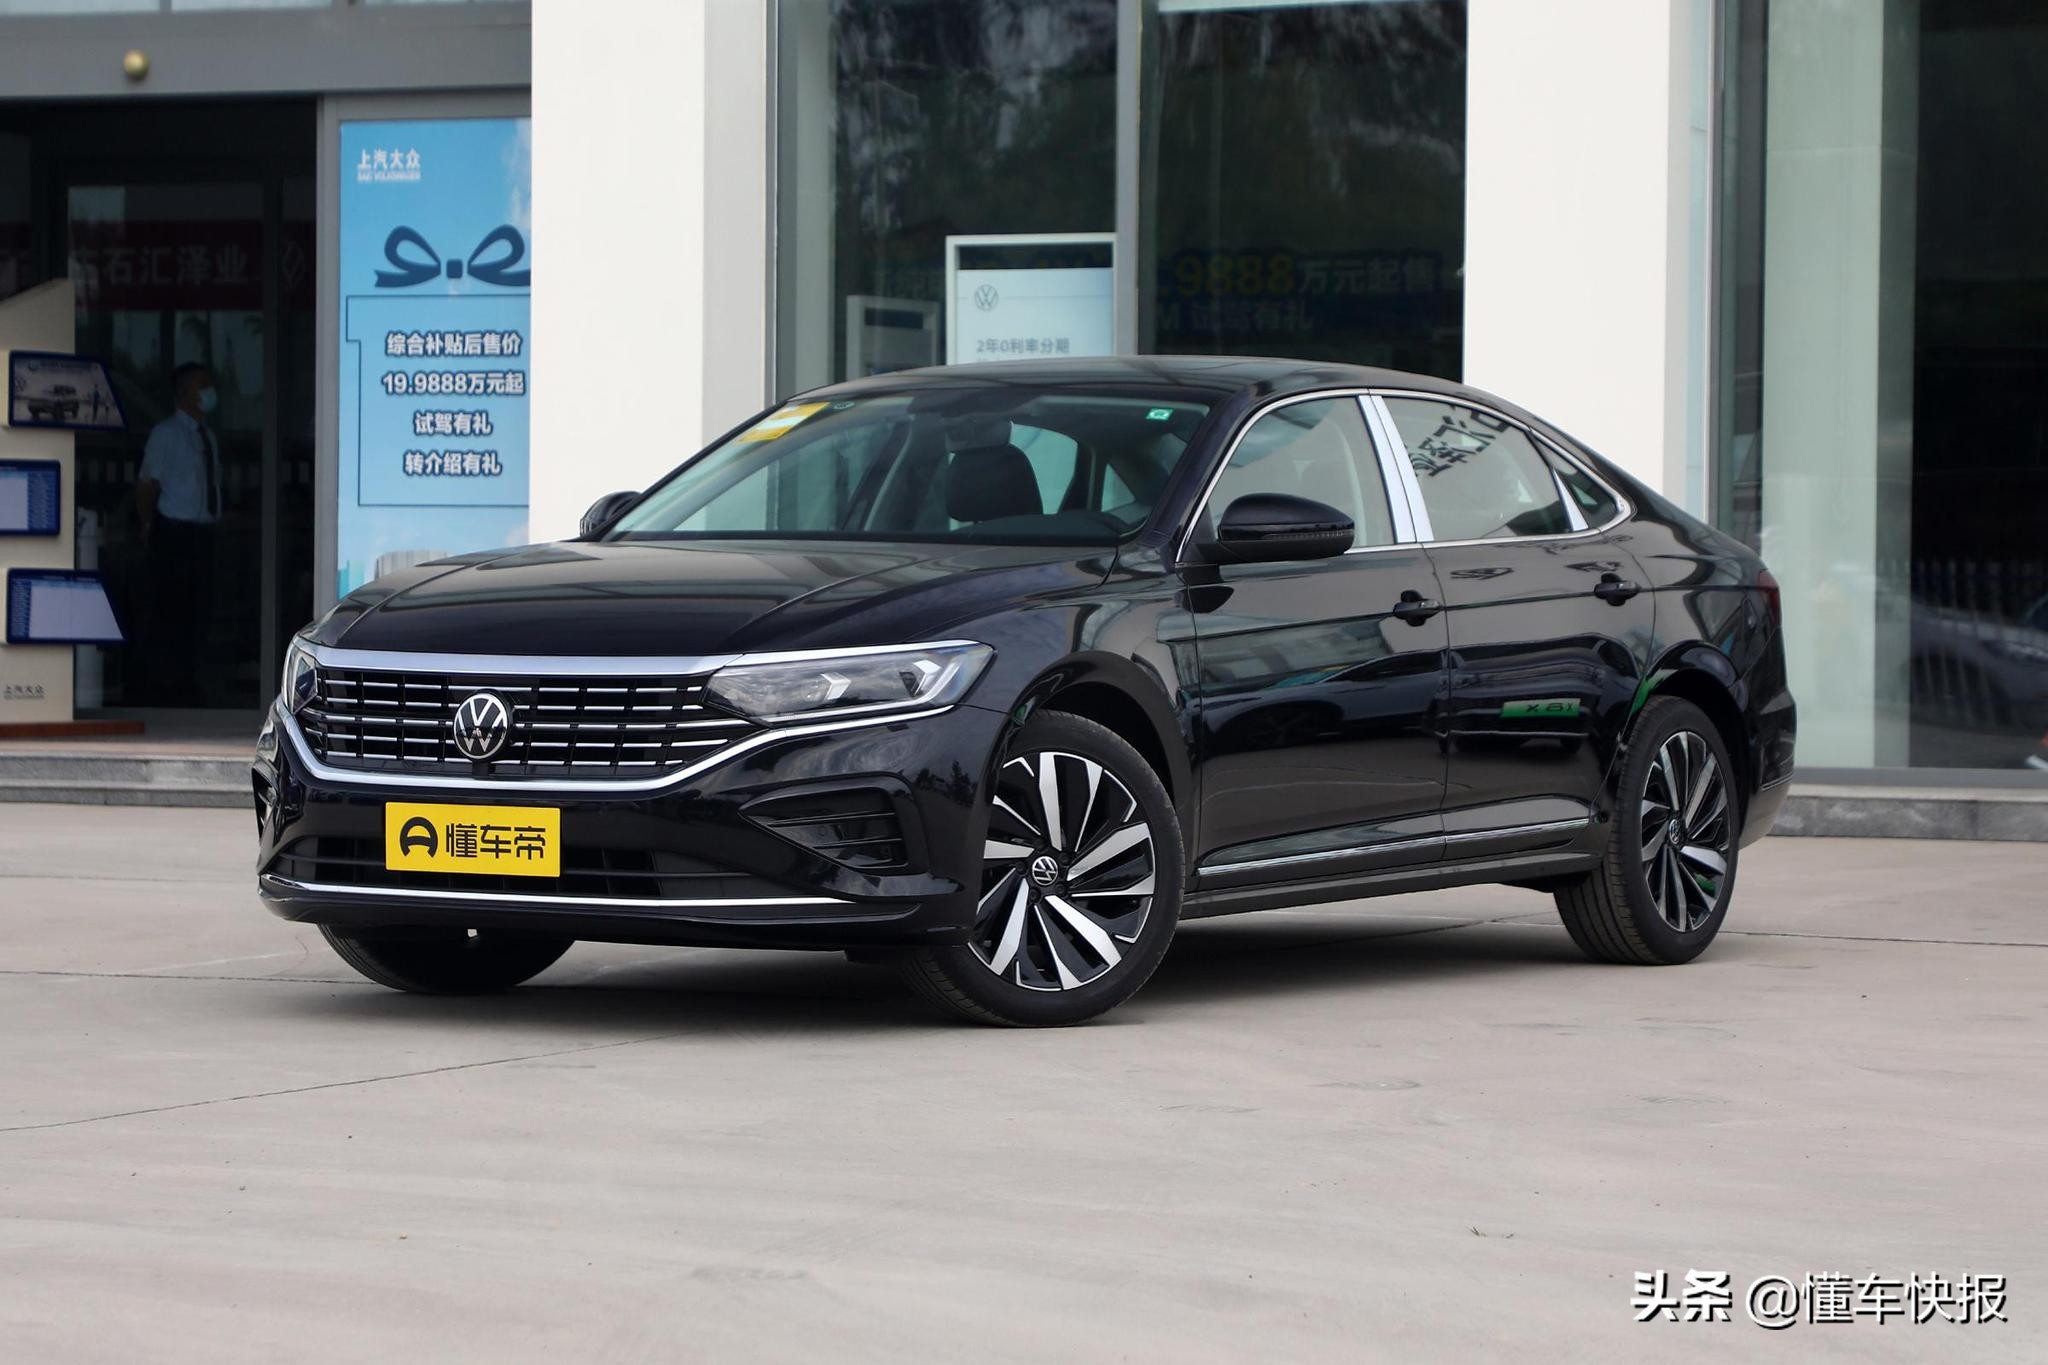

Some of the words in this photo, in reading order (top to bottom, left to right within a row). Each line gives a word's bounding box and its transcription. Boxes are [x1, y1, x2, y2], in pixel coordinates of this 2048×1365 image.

[357, 148, 421, 169] 上汽大众
[386, 332, 522, 356] 综合补贴后售价
[382, 371, 526, 396] 19.9888万元起
[414, 411, 493, 436] 试驾有礼
[403, 451, 503, 476] 转介绍有礼
[446, 823, 546, 860] 懂车帝
